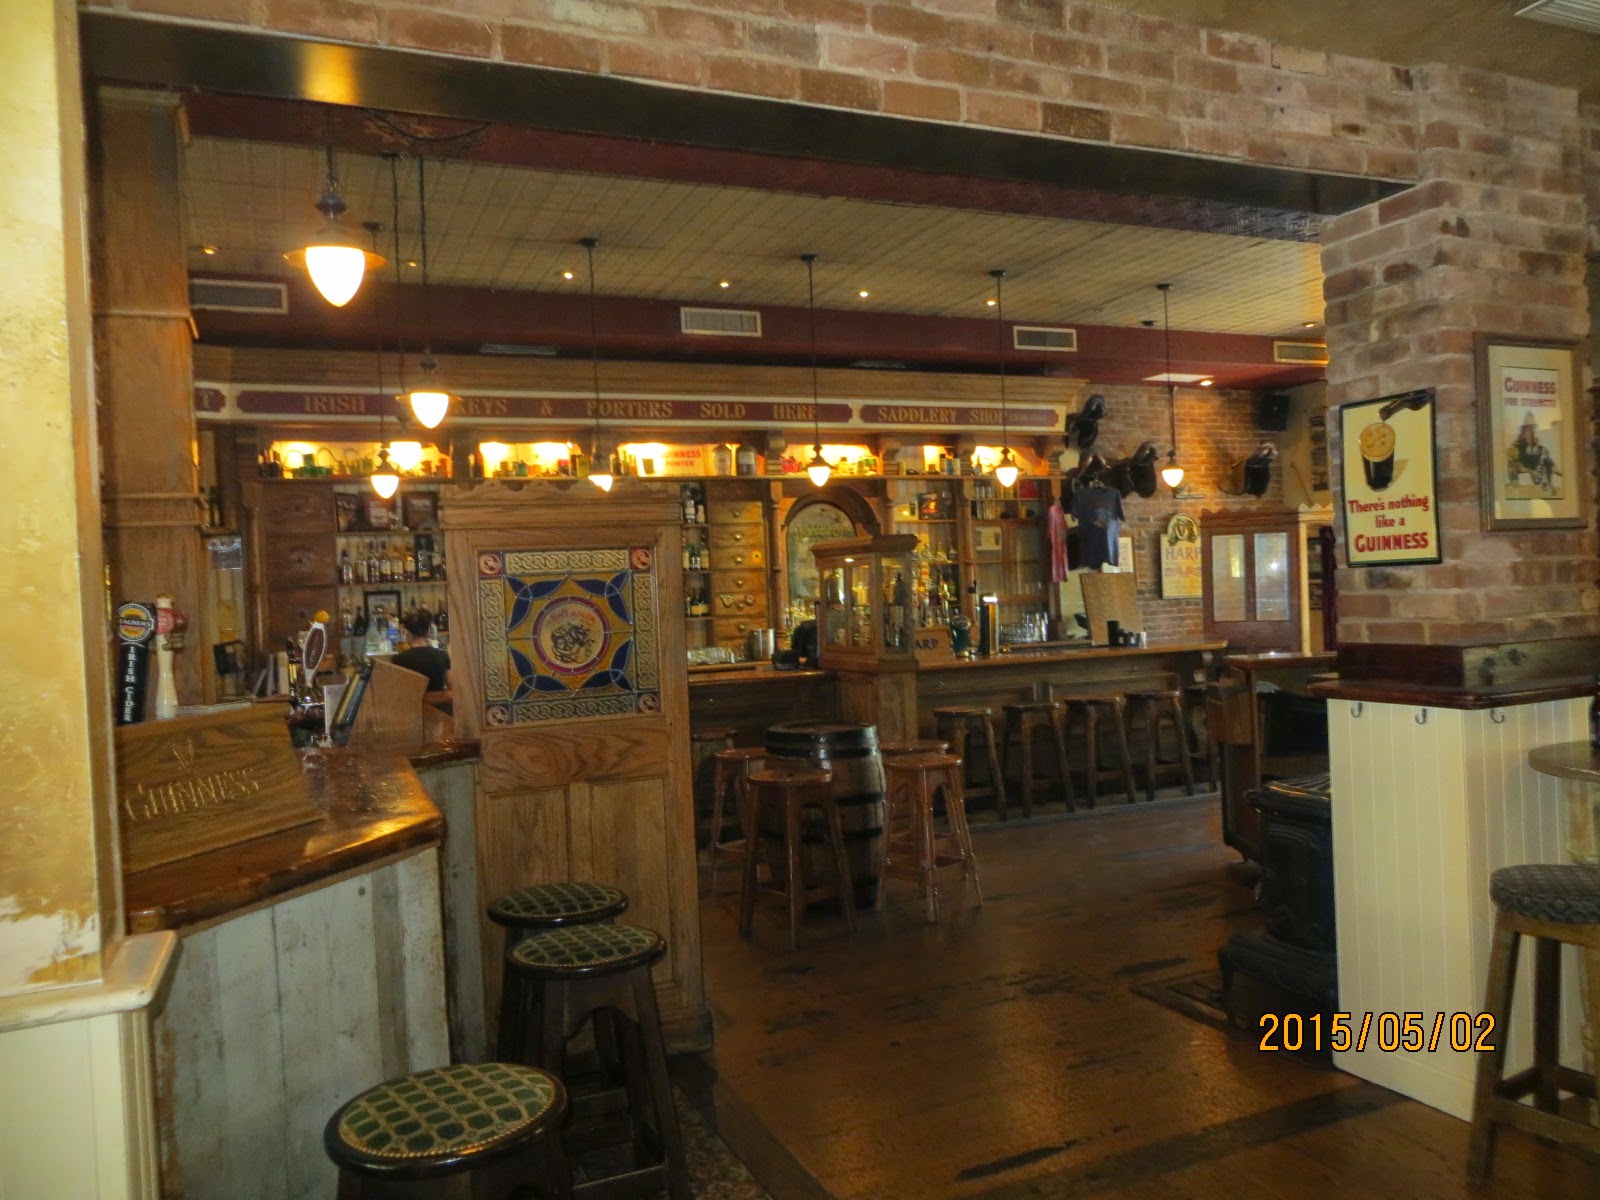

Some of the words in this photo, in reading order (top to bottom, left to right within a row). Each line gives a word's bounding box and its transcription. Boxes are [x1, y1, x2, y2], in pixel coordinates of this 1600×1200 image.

[1504, 376, 1556, 394] GUINNESS
[303, 394, 366, 414] IRISH
[539, 402, 553, 417] &
[586, 400, 672, 419] PORTERS
[700, 403, 746, 420] SOLD
[878, 406, 956, 424] SADDLERY
[1348, 497, 1385, 513] There's
[1387, 494, 1429, 512] nothing
[1374, 513, 1395, 528] like
[1398, 517, 1406, 526] a
[1354, 531, 1429, 553] GUINNESS
[125, 646, 136, 682] IRISH
